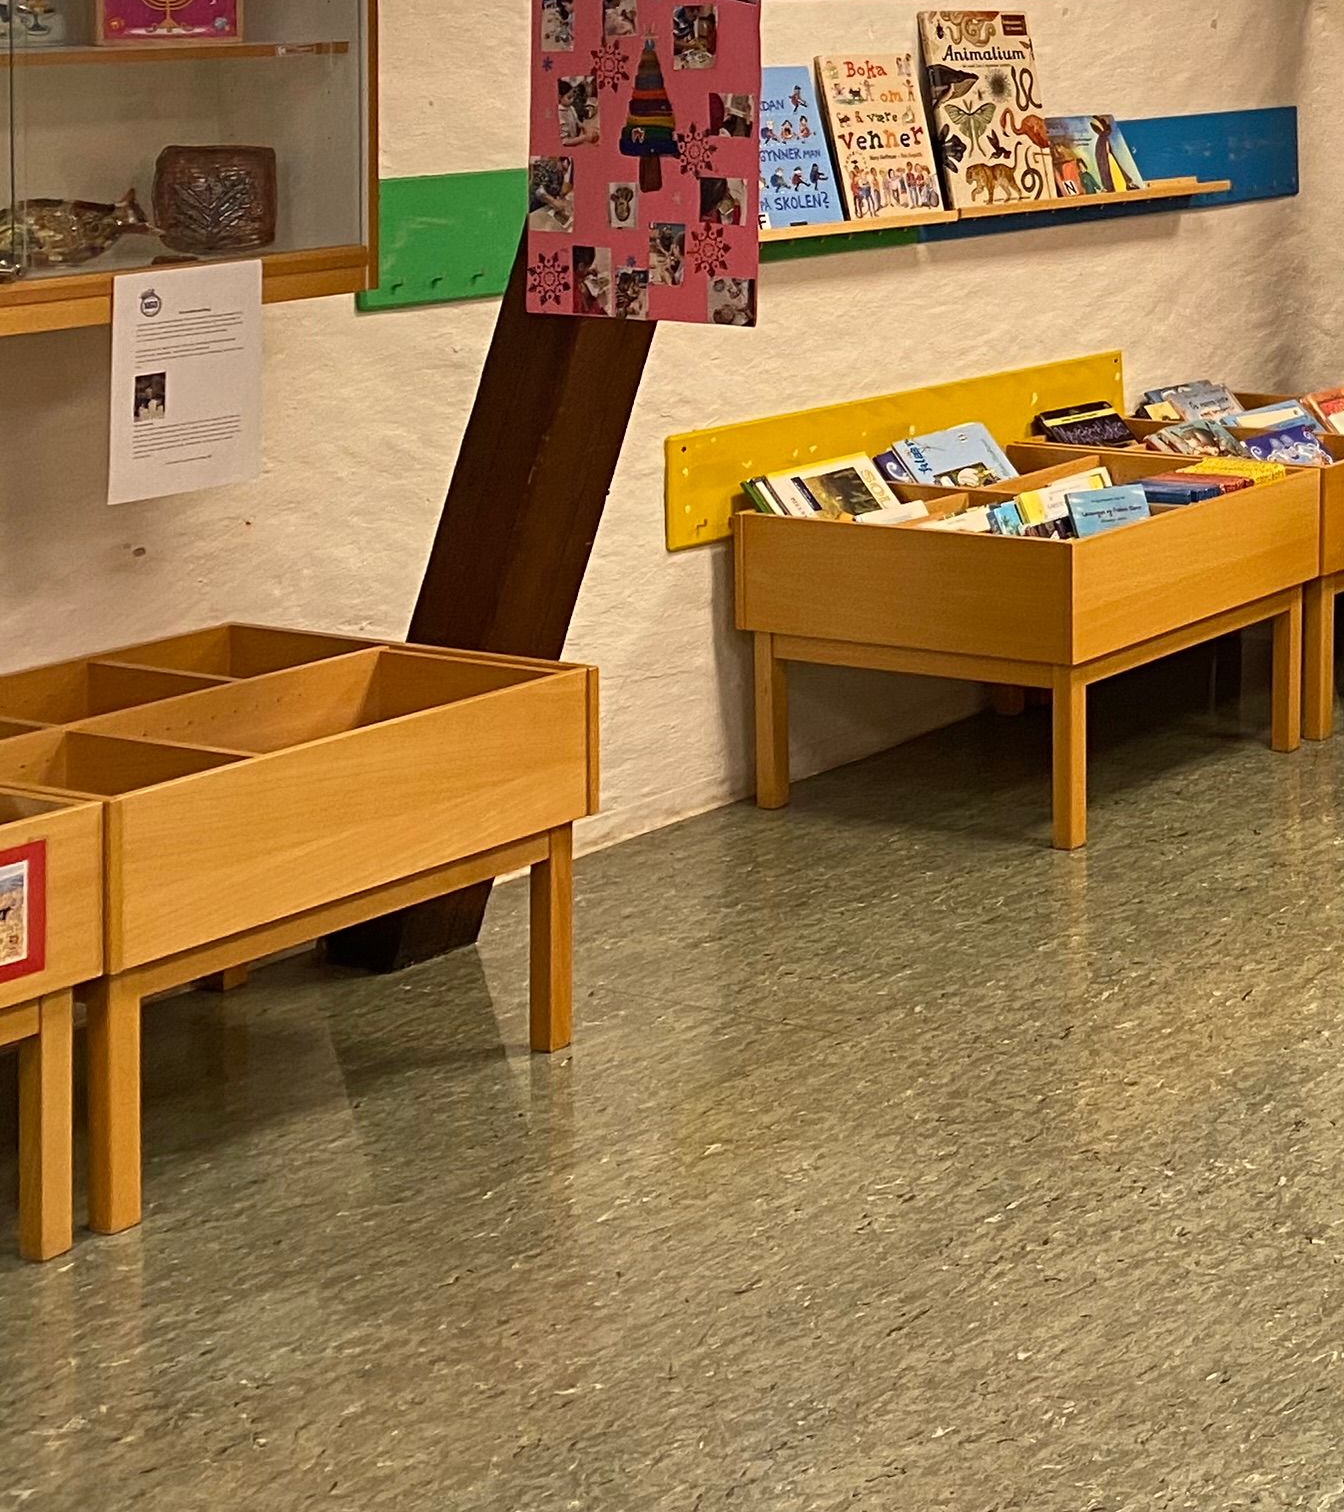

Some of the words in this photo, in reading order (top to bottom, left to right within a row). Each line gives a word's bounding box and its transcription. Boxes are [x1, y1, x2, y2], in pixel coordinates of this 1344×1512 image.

[942, 45, 1025, 62] Animalium
[843, 60, 887, 77] Boka
[880, 90, 903, 103] om
[854, 111, 864, 123] å
[866, 111, 898, 124] være
[838, 126, 924, 150] venner
[1064, 181, 1077, 195] N
[774, 192, 830, 211] SKOLEN?
